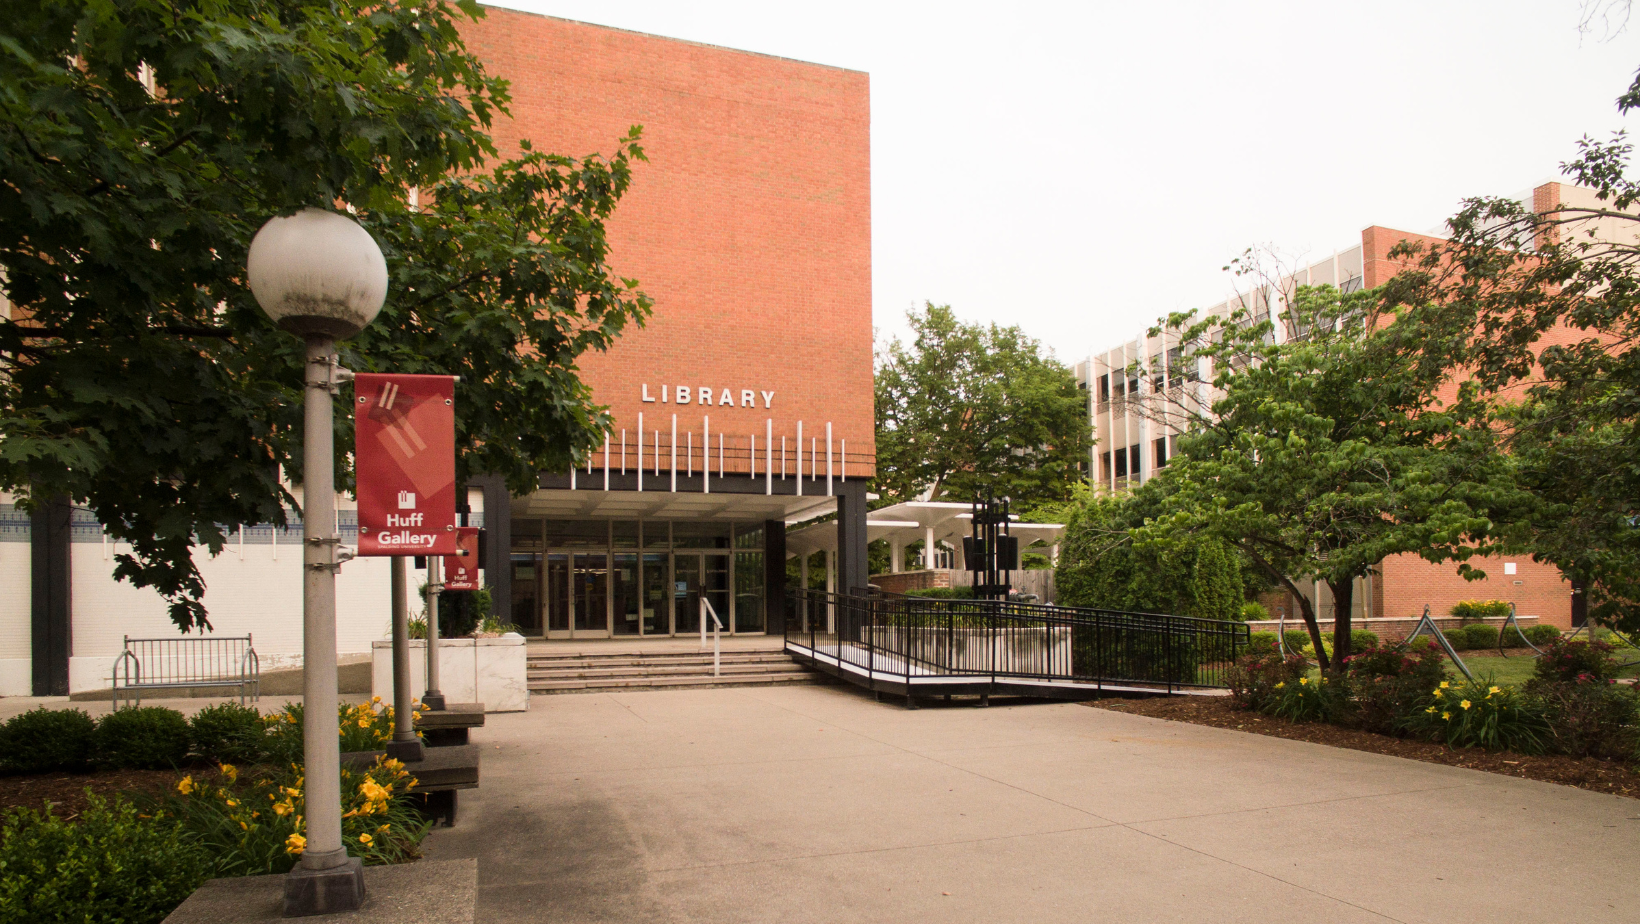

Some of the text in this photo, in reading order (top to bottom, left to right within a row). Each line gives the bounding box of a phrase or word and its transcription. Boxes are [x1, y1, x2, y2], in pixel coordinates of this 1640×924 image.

[642, 383, 775, 409] LIBRARY
[387, 513, 423, 526] Huff
[378, 530, 437, 547] Gallery
